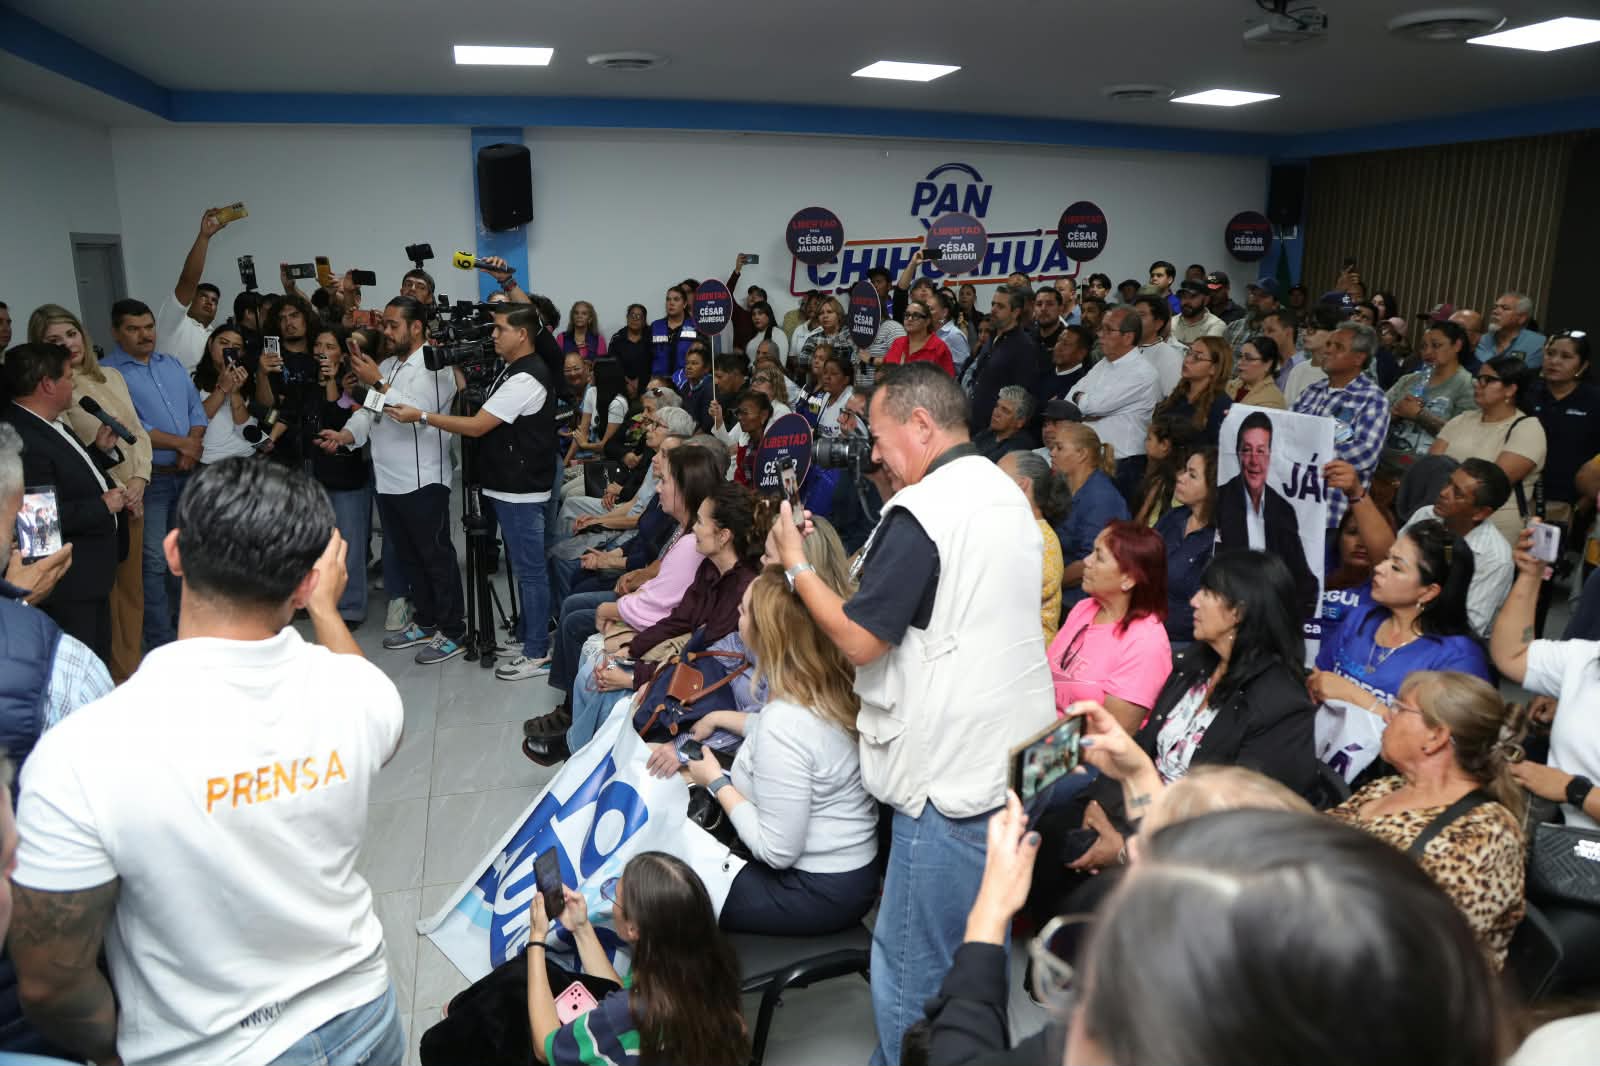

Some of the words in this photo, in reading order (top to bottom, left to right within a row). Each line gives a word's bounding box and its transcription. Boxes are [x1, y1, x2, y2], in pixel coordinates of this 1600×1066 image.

[911, 182, 993, 218] PAN
[798, 233, 832, 245] CÉSAR
[939, 241, 975, 252] CÉSAR
[808, 239, 1070, 287] CHIHHUA
[941, 251, 977, 261] ÁUREGUI
[699, 305, 724, 316] CÉSAR
[764, 433, 808, 449] LIBERTAD
[764, 457, 798, 474] CÉR
[207, 750, 348, 813] PRENSA
